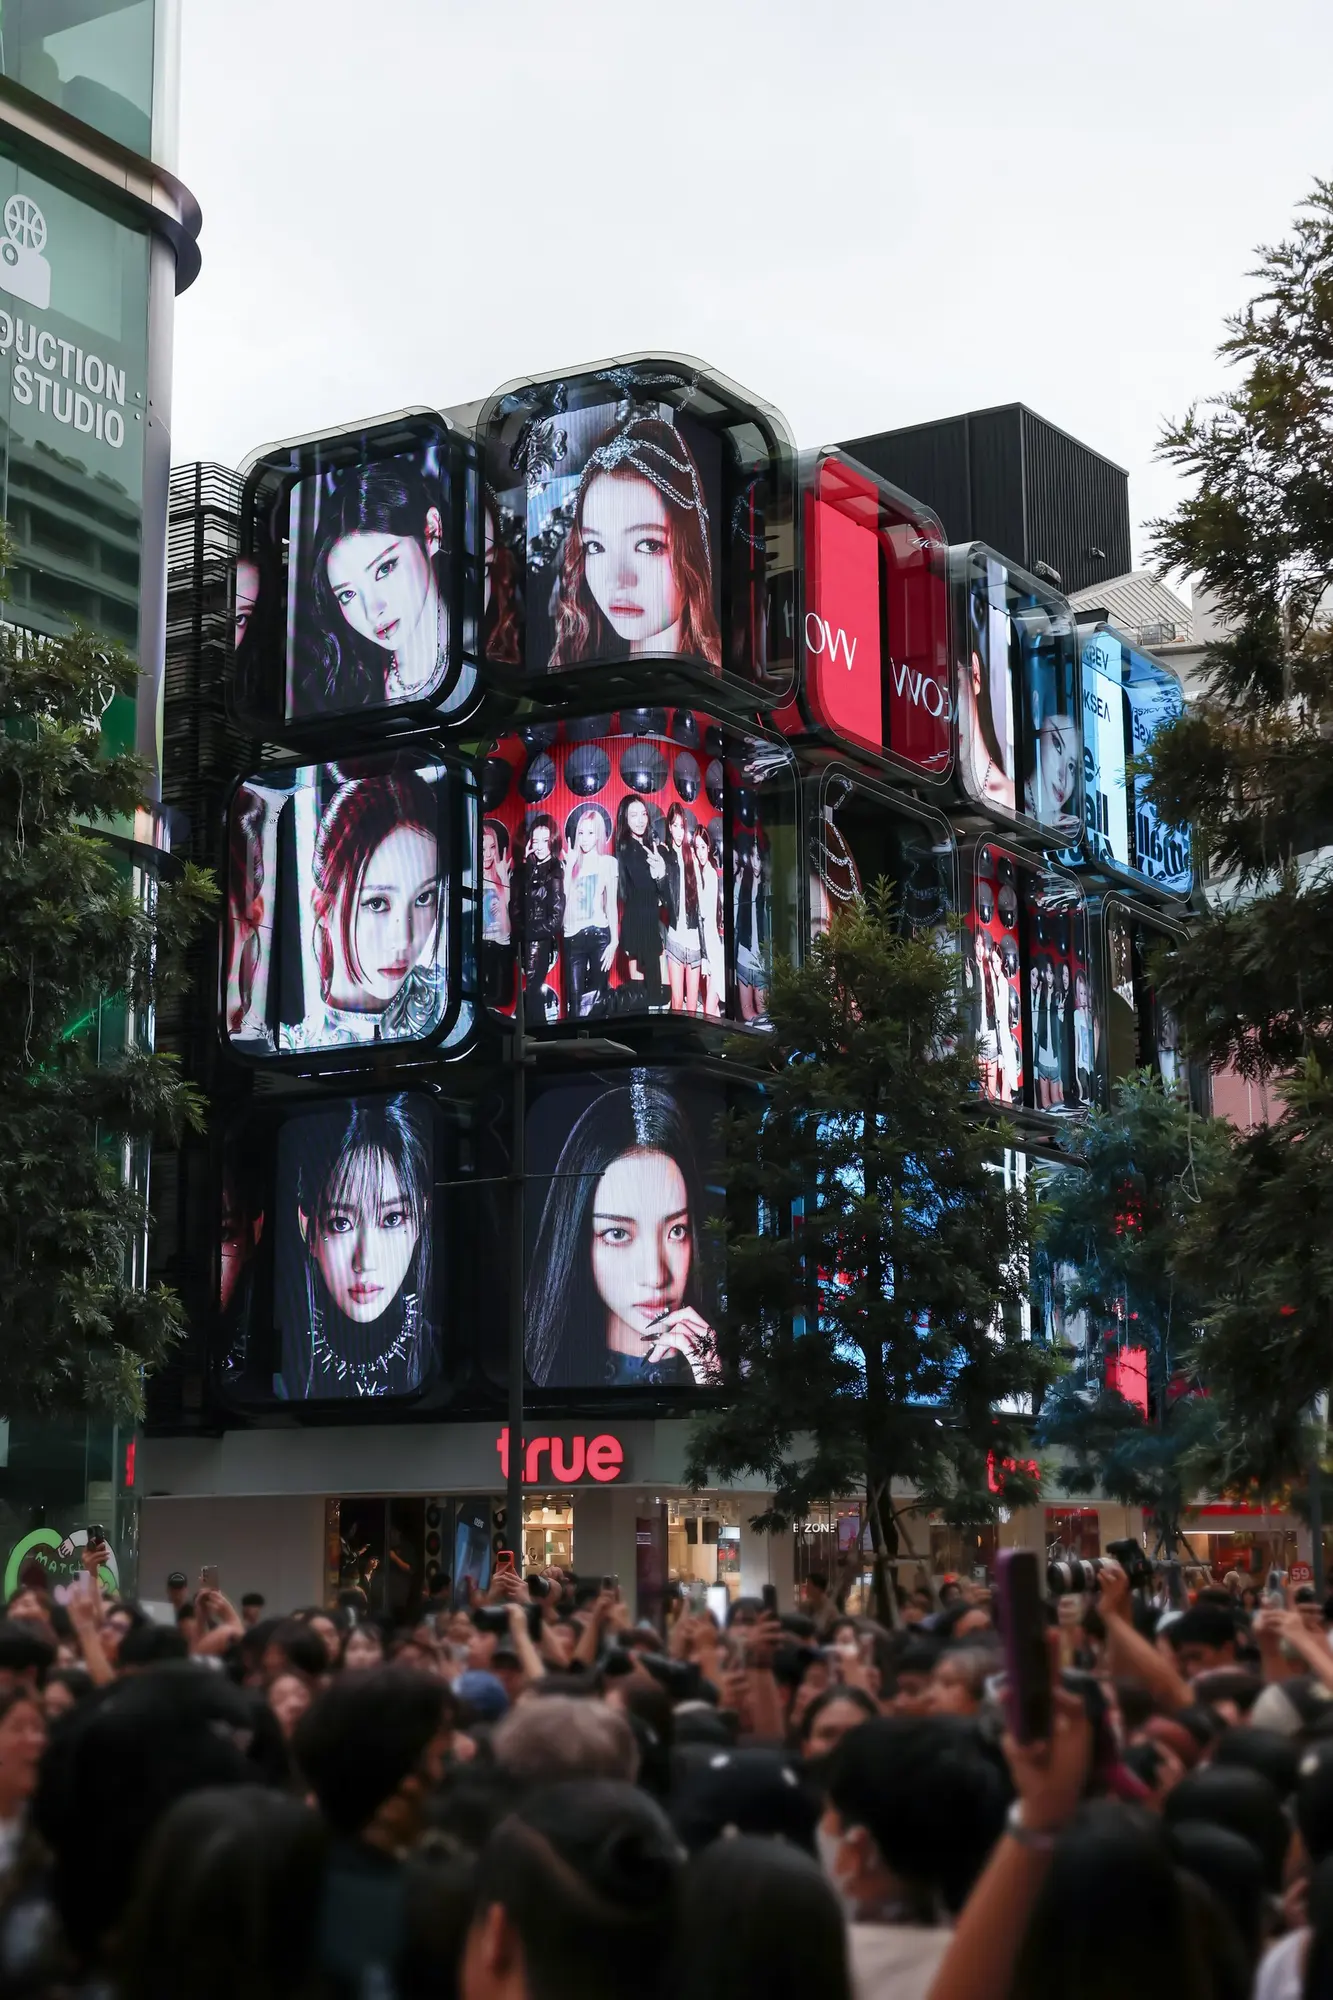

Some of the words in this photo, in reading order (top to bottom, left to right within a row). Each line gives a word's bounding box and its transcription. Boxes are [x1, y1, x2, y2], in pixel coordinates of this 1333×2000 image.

[12, 364, 125, 449] STUDIO
[804, 612, 858, 670] OW
[496, 1427, 624, 1483] true
[804, 1523, 836, 1534] ZONE
[1291, 1567, 1310, 1581] 59
